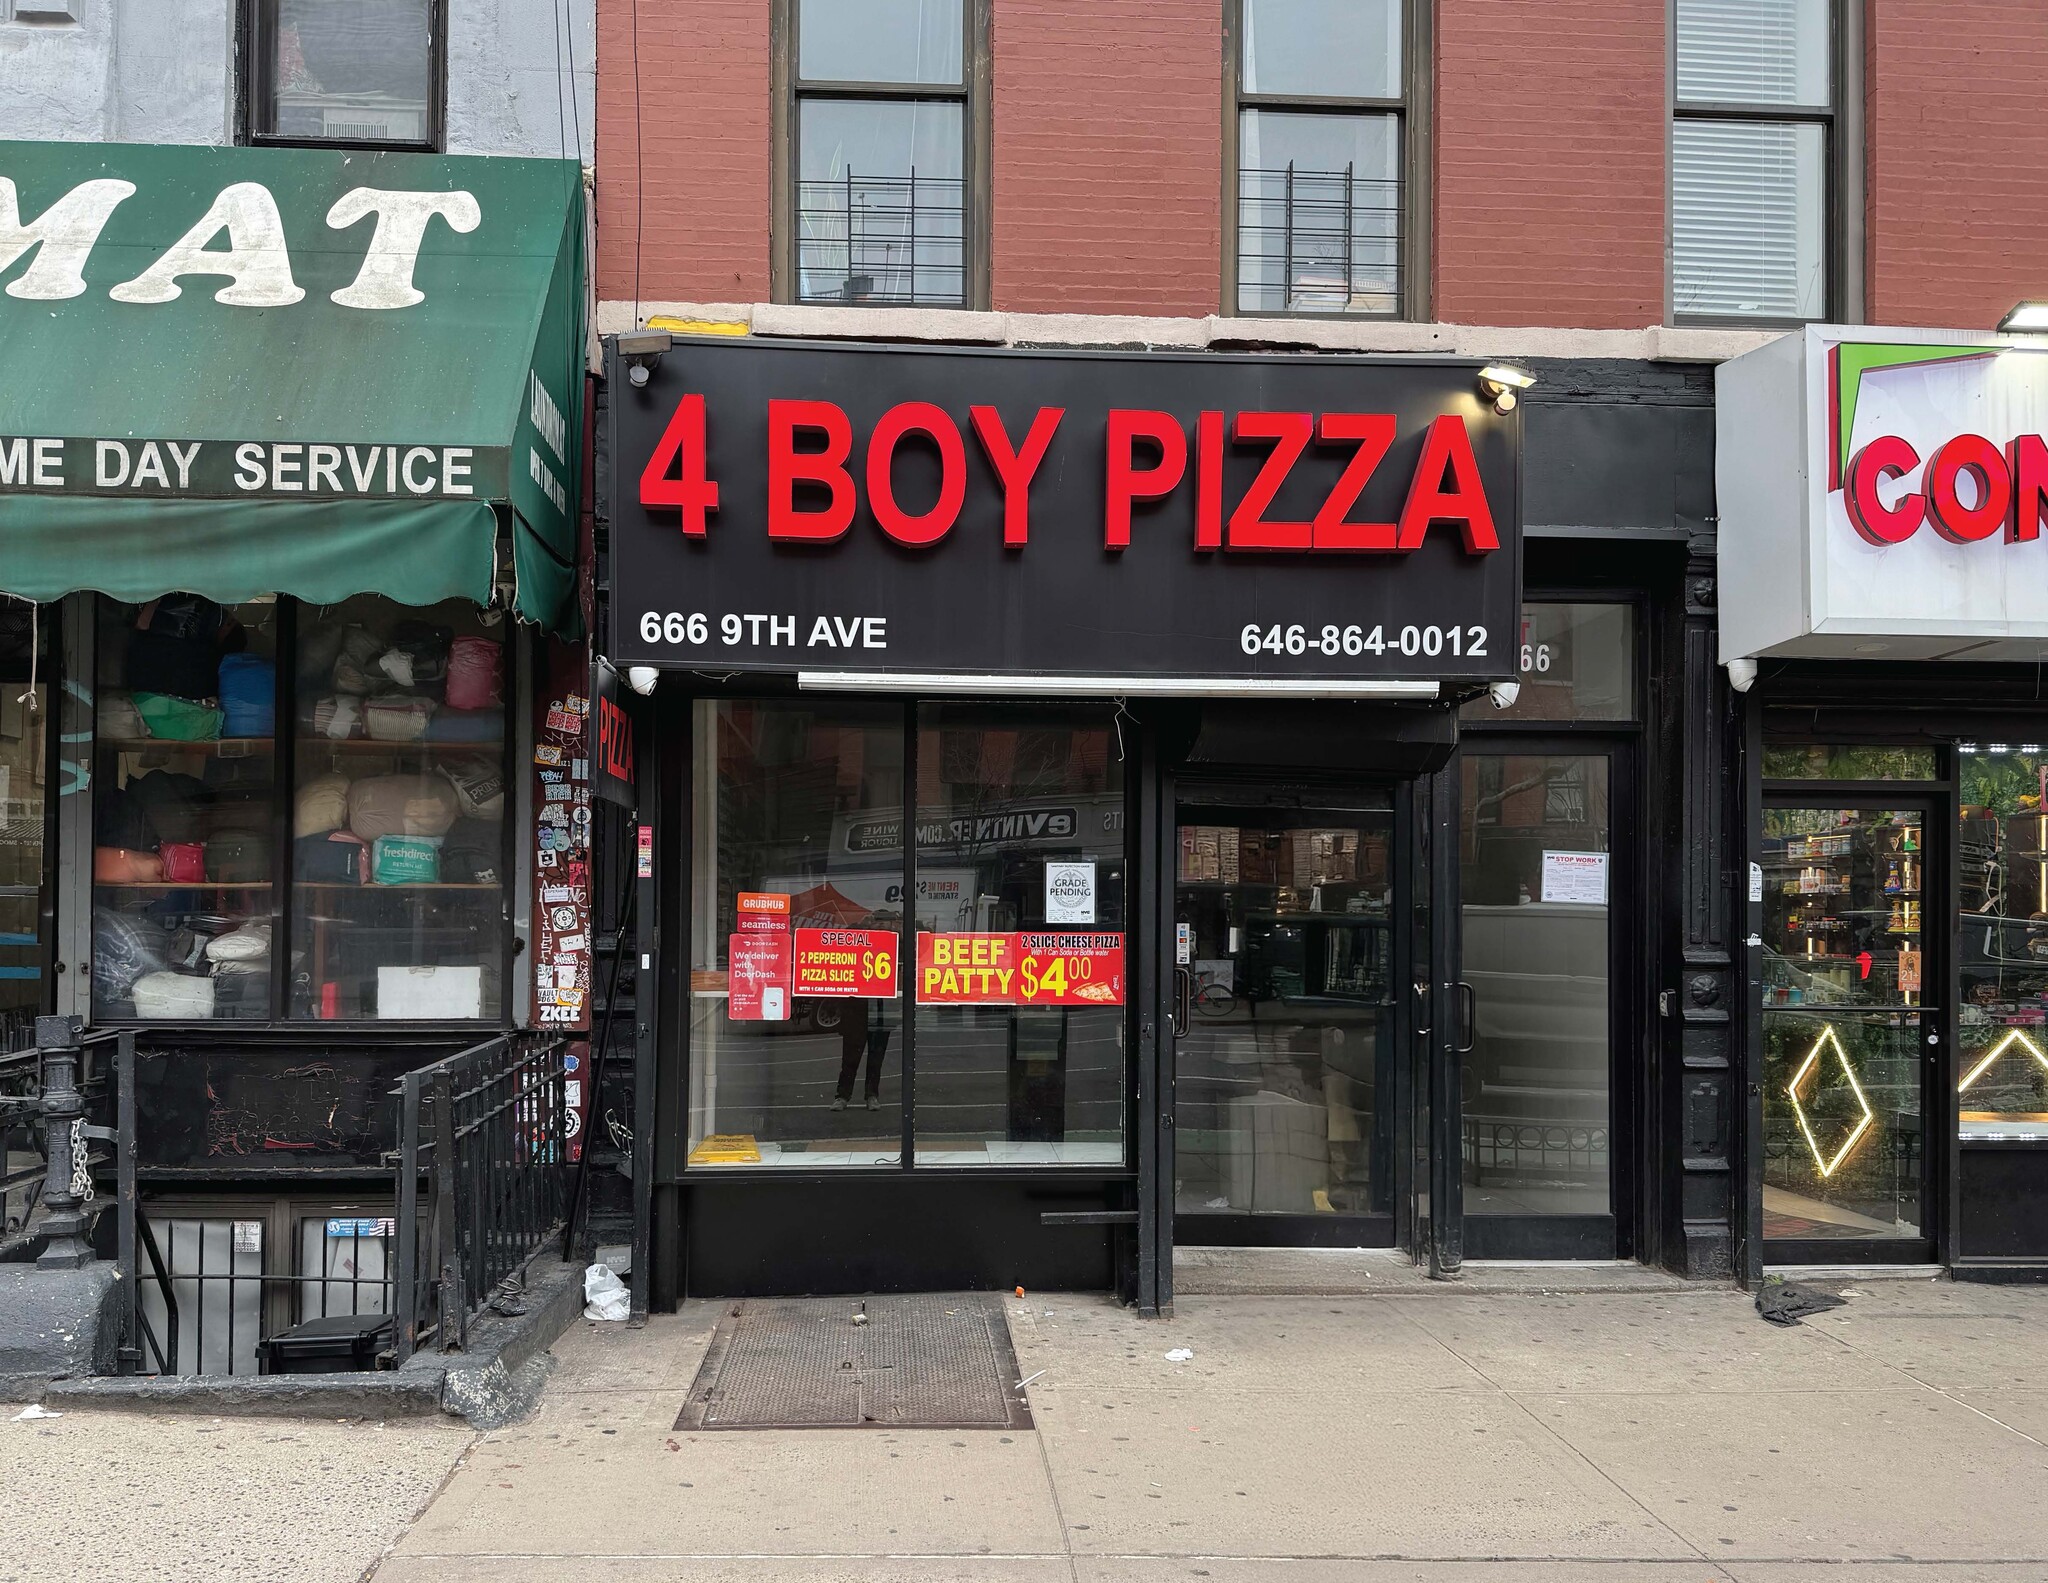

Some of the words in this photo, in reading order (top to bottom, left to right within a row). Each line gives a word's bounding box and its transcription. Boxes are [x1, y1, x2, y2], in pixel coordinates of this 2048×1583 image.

[96, 440, 201, 489] DAY
[233, 443, 473, 495] SERVICE
[640, 393, 719, 539] 4
[768, 398, 1066, 549] BOY
[1105, 408, 1500, 555] PIZZA
[640, 611, 708, 645] 666
[721, 613, 796, 647] 9TH
[807, 616, 887, 649] AVE
[1241, 623, 1488, 657] 646-864-0012
[600, 695, 634, 785] PIZZA
[384, 845, 434, 862] freshdirect
[1055, 879, 1087, 887] GRADE
[1050, 888, 1091, 896] PENDING
[743, 899, 785, 910] GRUBHUB
[742, 919, 786, 930] seamless
[822, 932, 872, 946] SPECIAL
[1022, 935, 1028, 948] 2
[1030, 935, 1056, 949] SLICE
[1058, 935, 1093, 949] CHEESE
[1095, 935, 1120, 949] PIZZA
[735, 951, 750, 960] We
[752, 951, 779, 960] deliver
[933, 938, 1006, 965] BEEF
[800, 953, 806, 964] 2
[808, 952, 857, 966] PEPPERONI
[862, 951, 891, 982] $6
[735, 970, 776, 979] DoorDash
[802, 968, 827, 982] PIZZA
[830, 970, 855, 982] SLICE
[924, 967, 1015, 995] PATTY
[1901, 969, 1919, 981] 21+
[540, 1005, 581, 1022] ZKEE
